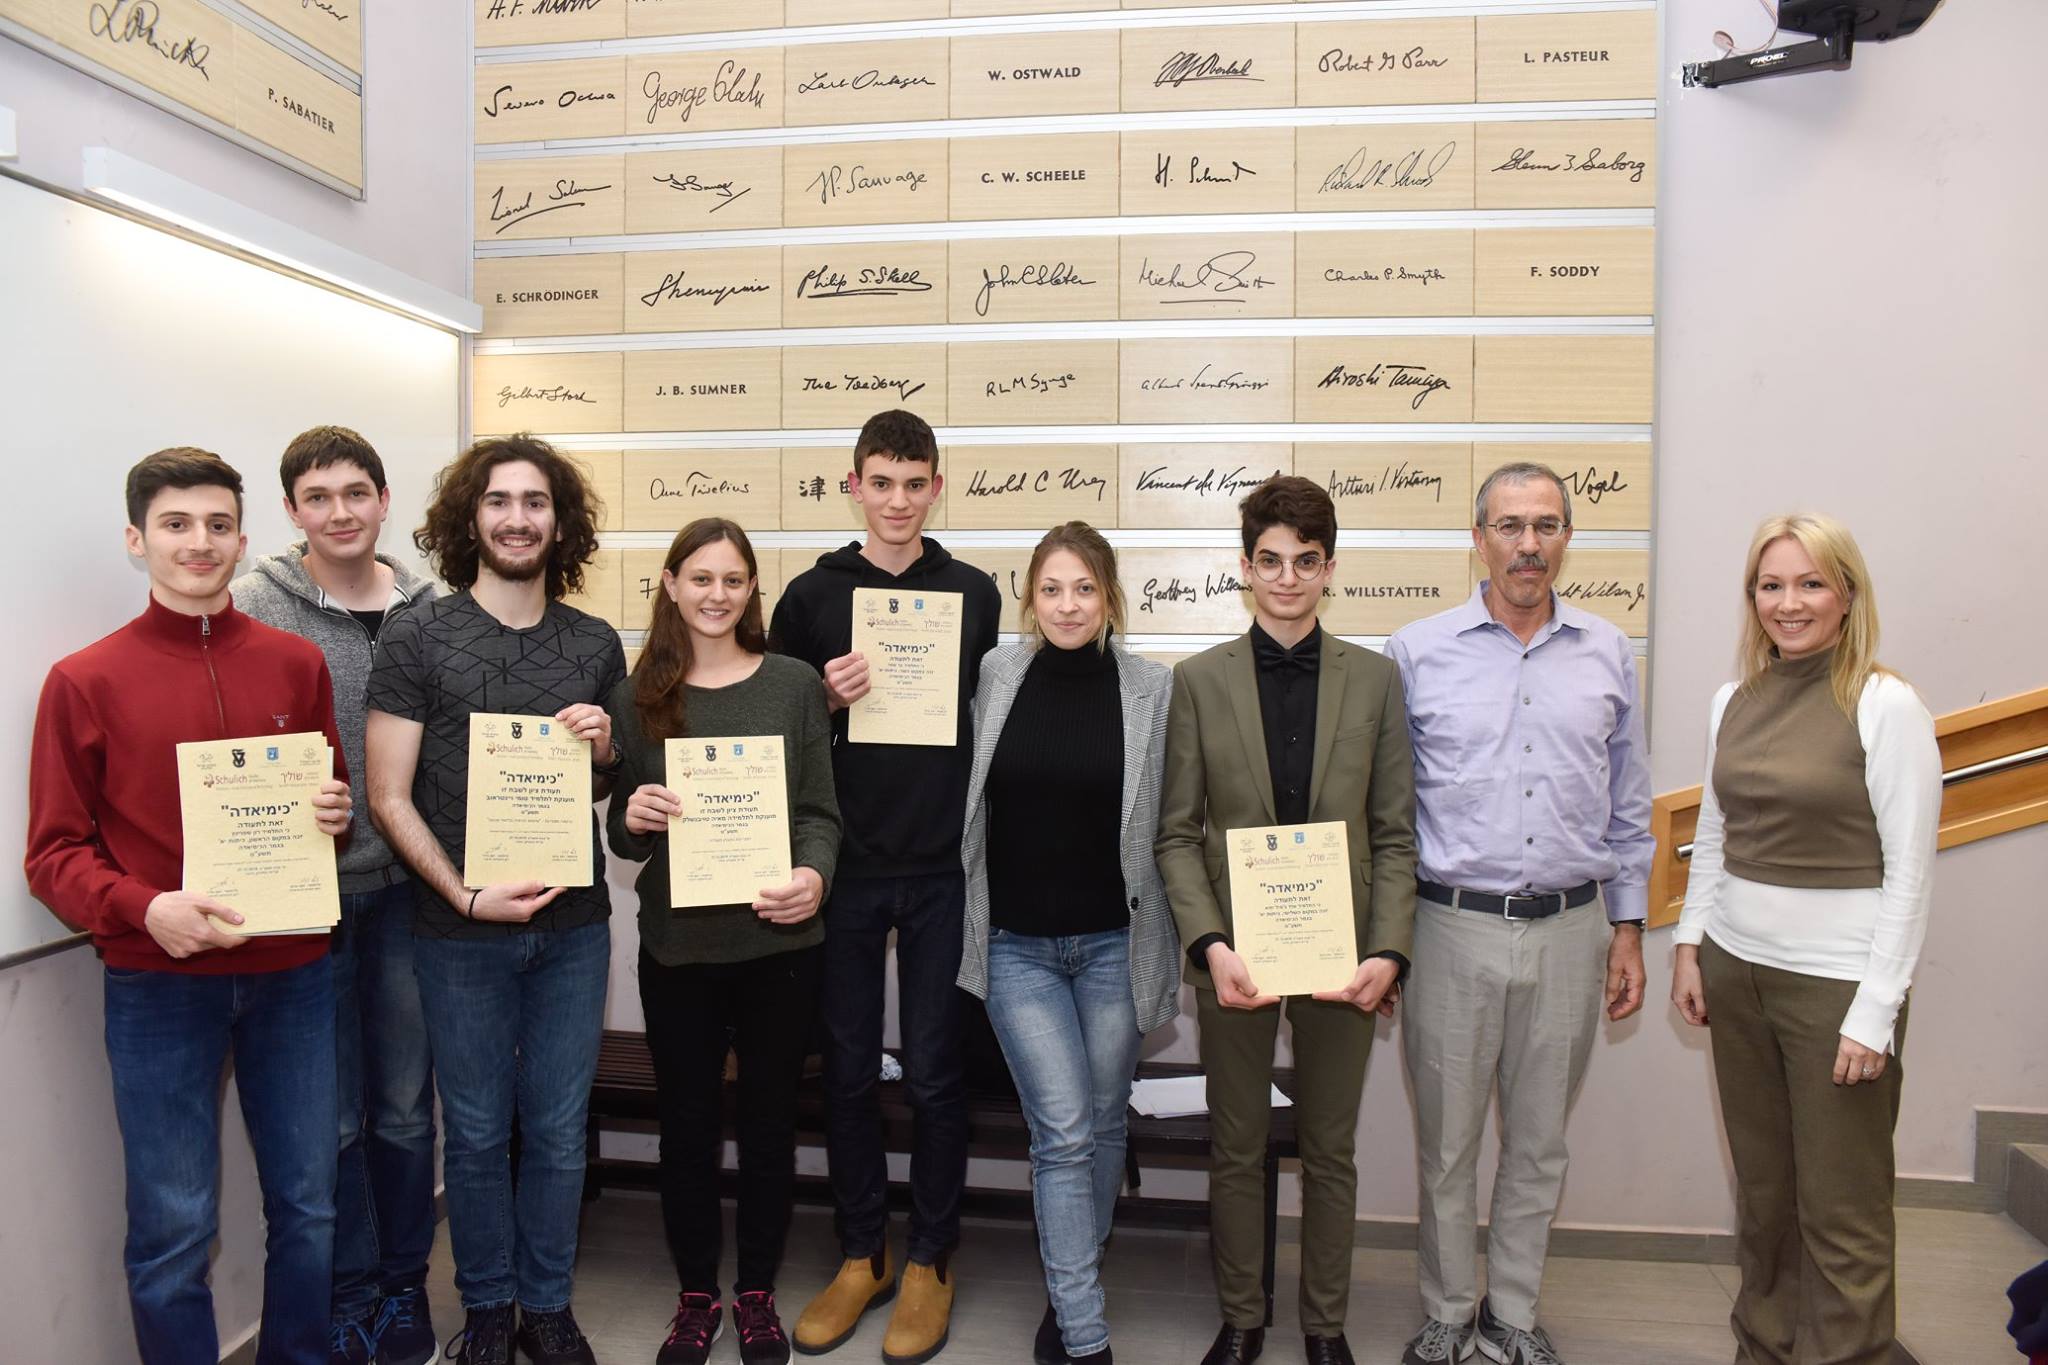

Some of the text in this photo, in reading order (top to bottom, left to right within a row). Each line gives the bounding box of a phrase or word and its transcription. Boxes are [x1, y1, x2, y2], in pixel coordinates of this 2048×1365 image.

[1319, 49, 1374, 72] Robert
[1402, 46, 1448, 69] Parr
[1524, 50, 1610, 63] L. PASTEUR
[988, 67, 1081, 81] W. OSTWALD
[484, 85, 616, 118] Severo Ochoa
[643, 71, 708, 124] George
[268, 87, 335, 135] P. SABATIER
[1155, 153, 1173, 187] H.
[1574, 148, 1646, 182] Seaborg
[846, 165, 928, 193] Sauvage
[981, 169, 1086, 184] C. W. SCHEELE
[1324, 266, 1446, 286] Charles P. Smyth
[1531, 265, 1600, 278] F. SODDY
[797, 265, 847, 299] Philip
[975, 265, 1020, 317] John
[1037, 262, 1097, 286] Slater
[496, 289, 599, 304] E. SCHRÖDINGER
[986, 373, 1076, 397] R L M Synge
[1317, 364, 1386, 388] Hiroshi
[656, 383, 747, 397] J. B. SUMNER
[966, 470, 1027, 497] Harold
[1034, 470, 1049, 492] C
[1136, 466, 1198, 491] Vincent
[1562, 466, 1628, 504] Vogel
[1322, 587, 1336, 597] R.
[1580, 582, 1632, 599] Wilson
[878, 641, 935, 654] "כימיאדה"
[215, 774, 248, 785] Schulich
[499, 771, 564, 785] "כימיאדה"
[697, 791, 760, 804] "כימיאדה"
[221, 801, 299, 817] "כימיאדה"
[1260, 879, 1323, 894] "כימיאדה"
